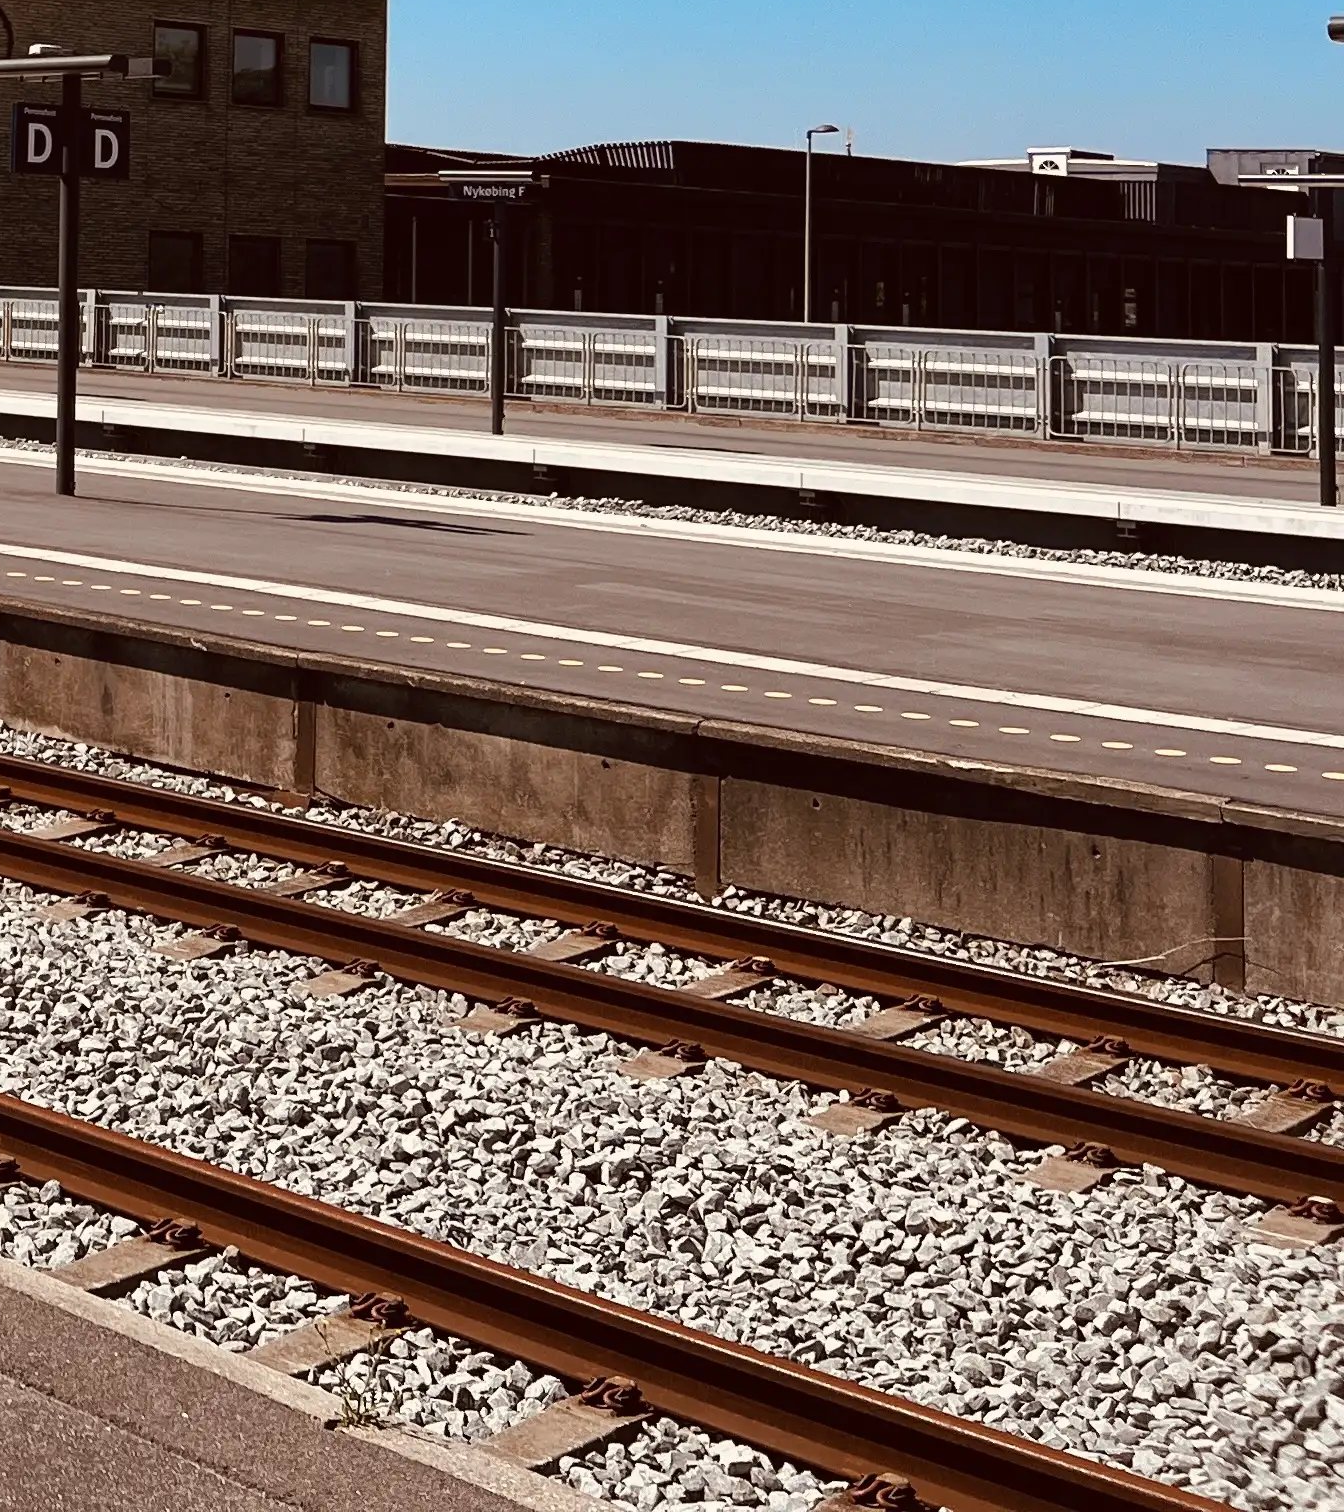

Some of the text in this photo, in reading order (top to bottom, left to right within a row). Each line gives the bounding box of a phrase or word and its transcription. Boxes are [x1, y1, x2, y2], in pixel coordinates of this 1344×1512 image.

[27, 122, 53, 163] D
[94, 129, 119, 169] D
[463, 186, 526, 199] Nykøbing F
